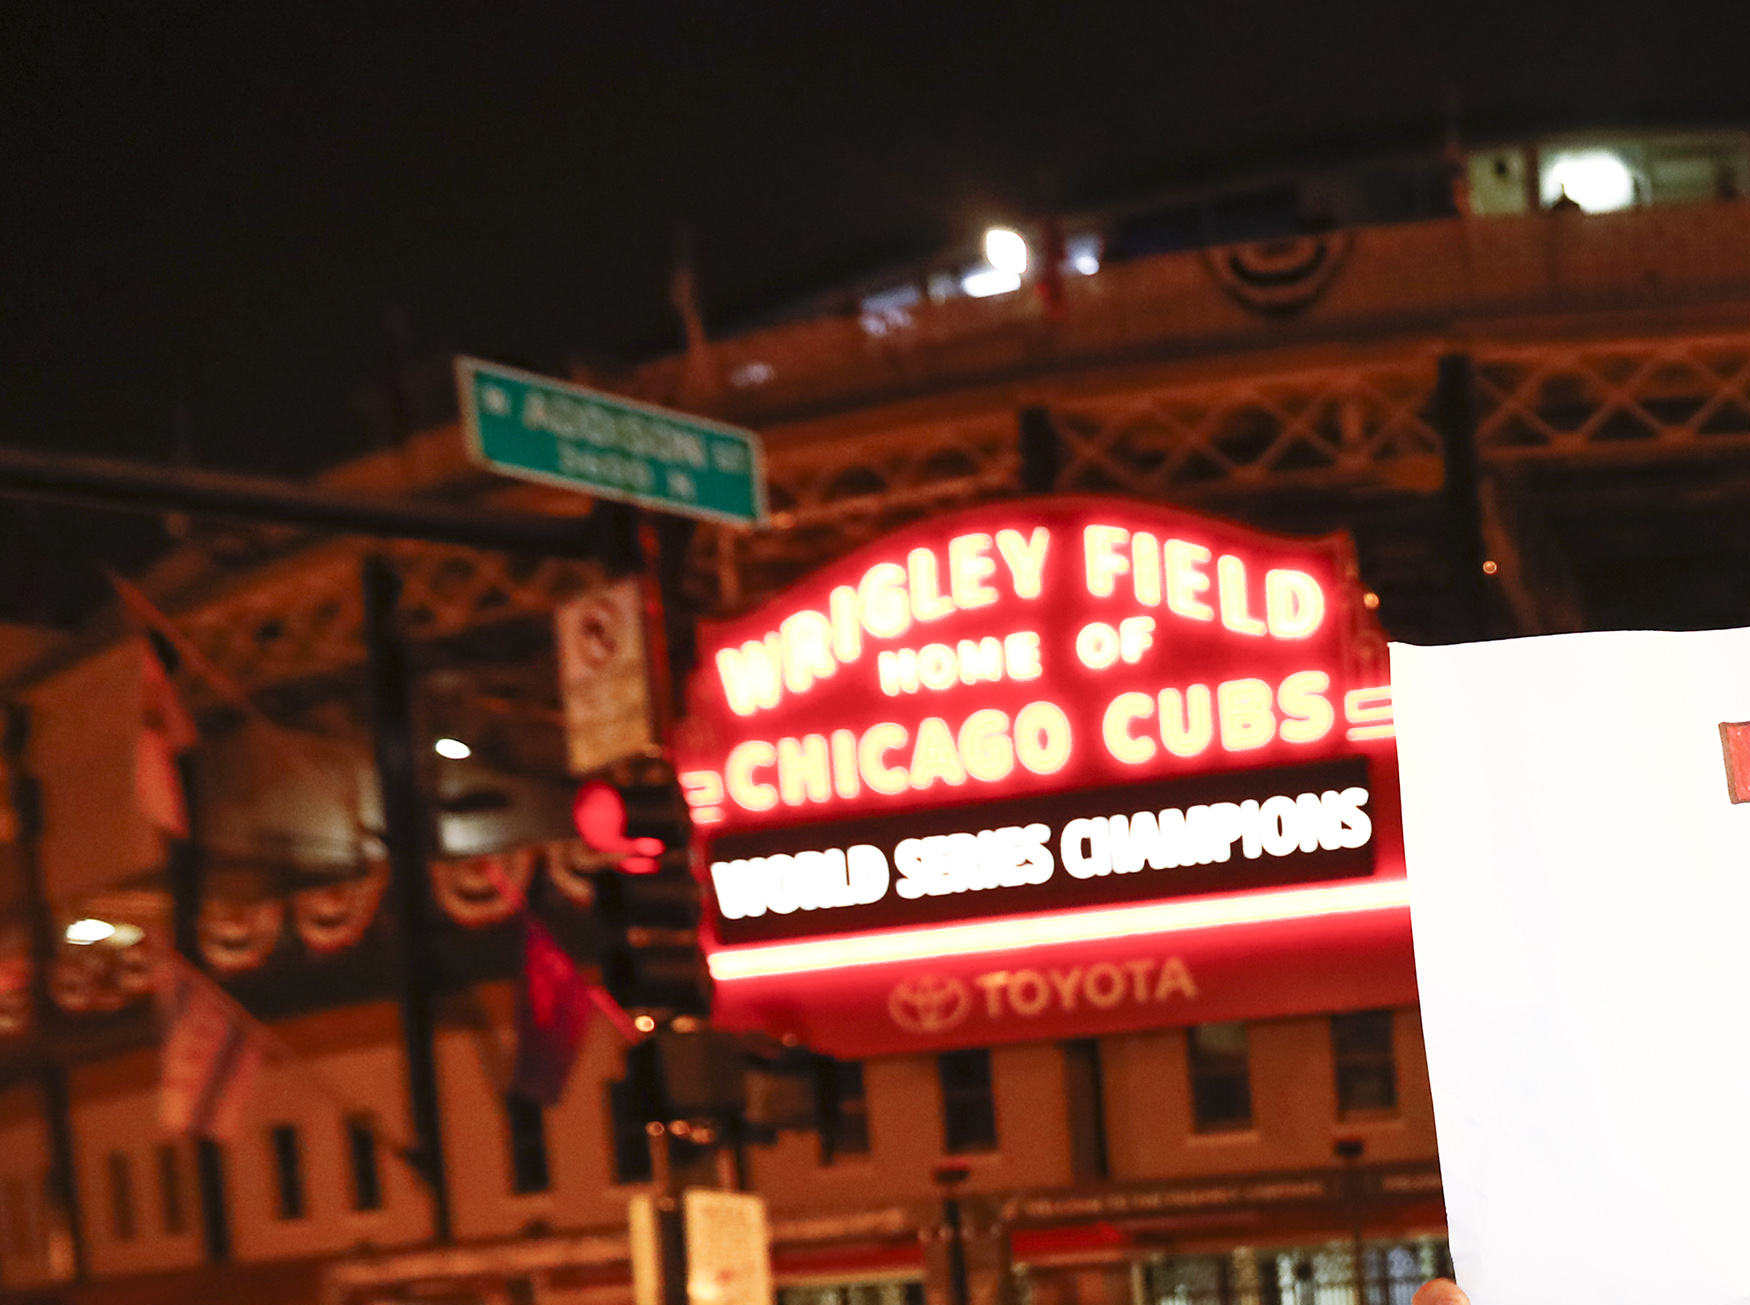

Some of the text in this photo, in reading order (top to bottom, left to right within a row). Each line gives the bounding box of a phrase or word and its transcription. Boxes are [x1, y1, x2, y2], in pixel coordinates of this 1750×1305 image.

[716, 524, 1325, 716] WRIGLEY FIELD
[877, 615, 1156, 697] HOME OF
[723, 700, 1073, 813] CHICAGO
[1101, 670, 1335, 766] CUBS
[710, 787, 1373, 920] WORLD SERIES CHAMPIONS
[974, 956, 1200, 1021] TOYOTA
